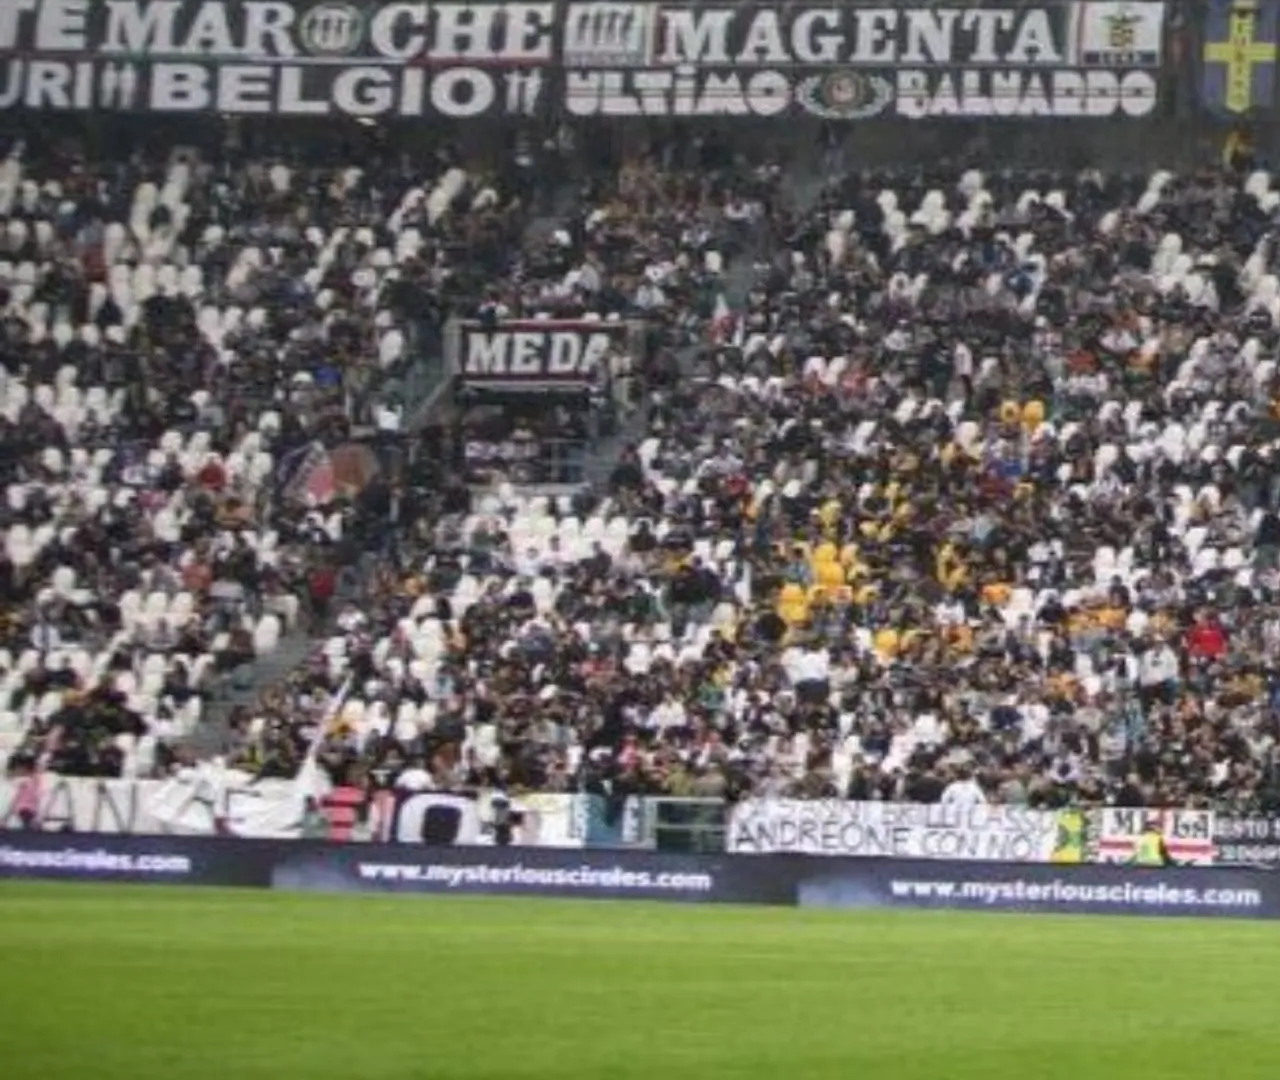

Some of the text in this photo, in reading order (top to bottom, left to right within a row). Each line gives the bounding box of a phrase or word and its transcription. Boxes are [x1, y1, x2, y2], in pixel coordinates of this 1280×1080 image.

[659, 7, 1062, 64] MAGENTA
[150, 62, 495, 116] BELGIO
[465, 331, 611, 374] MEDA
[359, 858, 711, 893] www.mysteriouscircles.com
[890, 876, 1262, 909] www.mysteriouscircles.com
